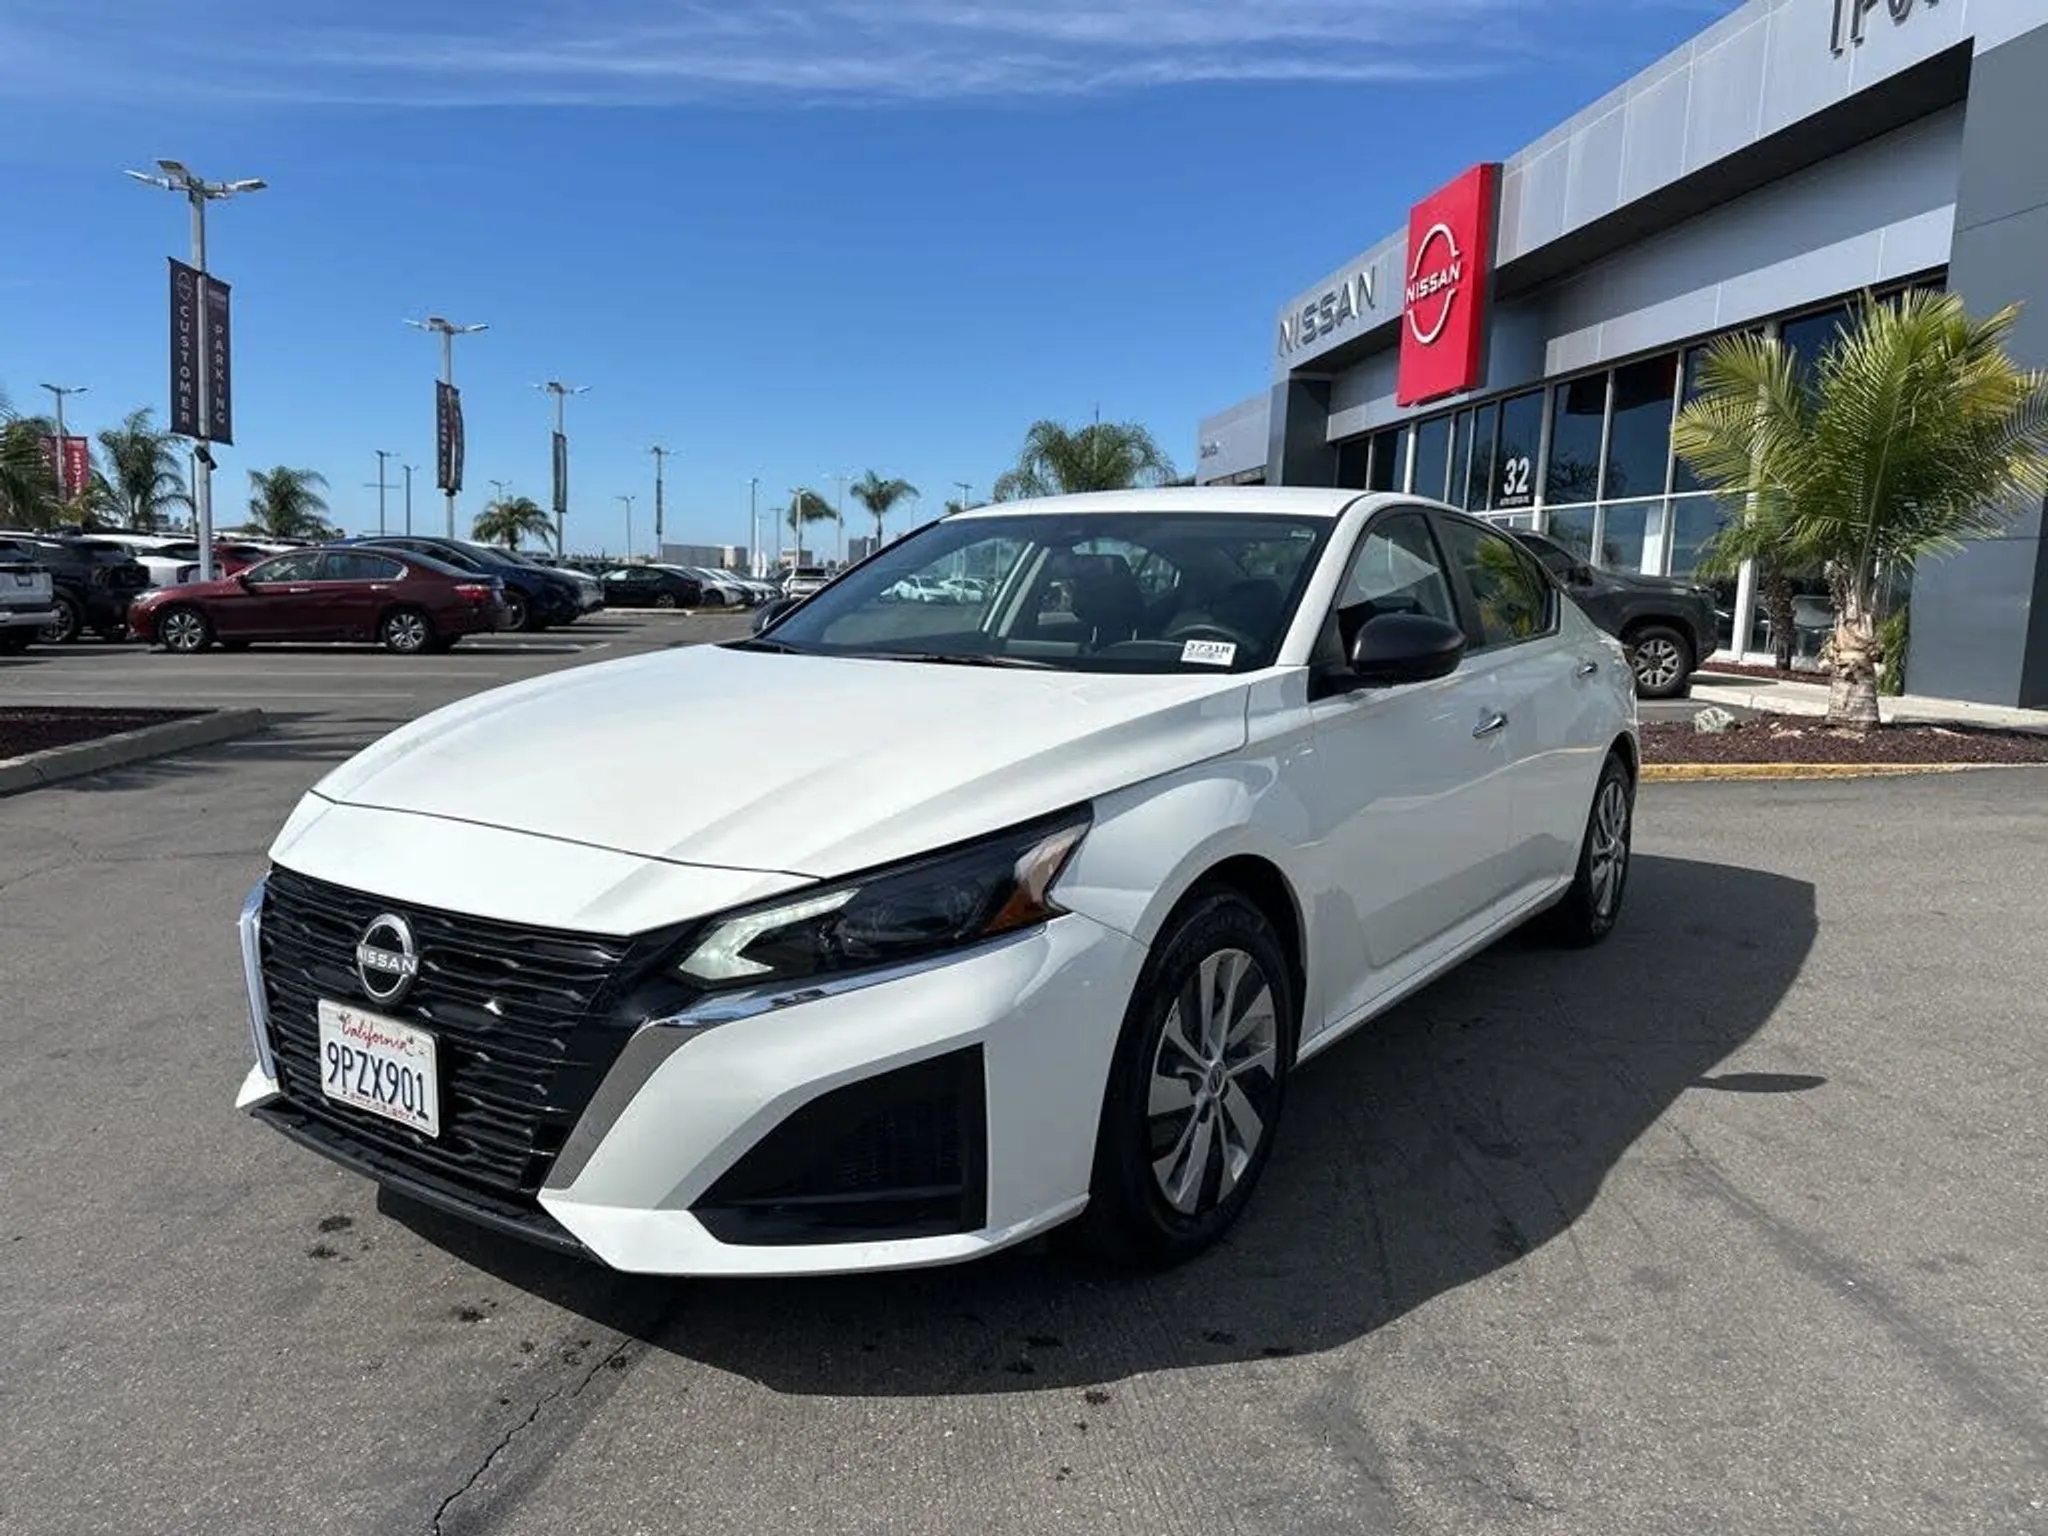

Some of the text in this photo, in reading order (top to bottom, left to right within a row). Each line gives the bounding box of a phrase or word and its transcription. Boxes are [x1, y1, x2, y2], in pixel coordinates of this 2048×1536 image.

[1280, 264, 1376, 357] NISSAN
[1406, 261, 1461, 303] NISSAN
[179, 305, 192, 423] CUSTOMER
[214, 323, 226, 424] PARKING
[1504, 456, 1529, 495] 32
[341, 1014, 410, 1052] California
[328, 1041, 429, 1120] 9PZX901
